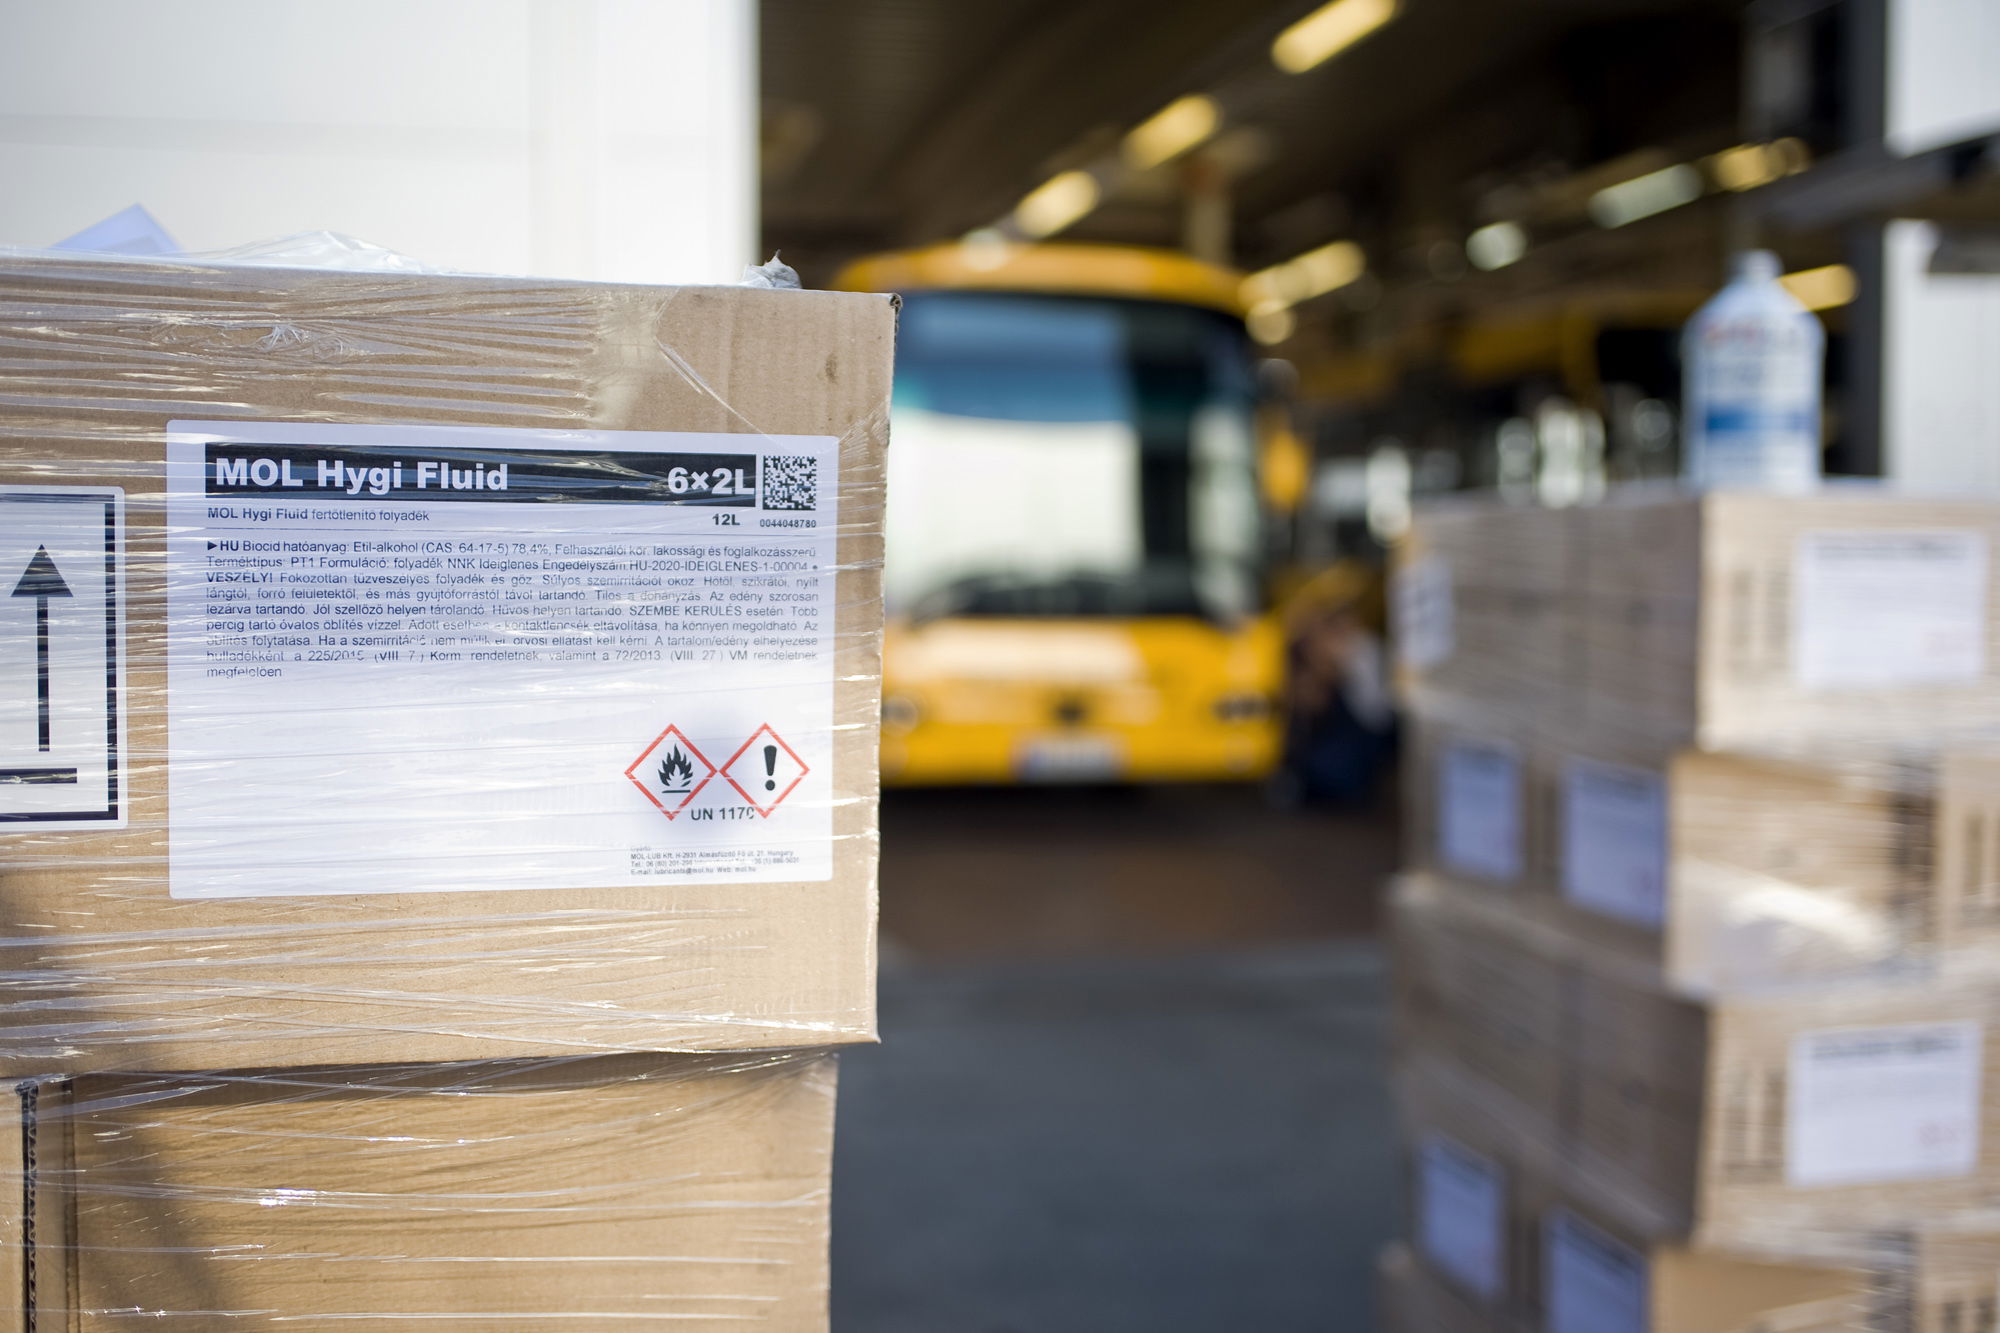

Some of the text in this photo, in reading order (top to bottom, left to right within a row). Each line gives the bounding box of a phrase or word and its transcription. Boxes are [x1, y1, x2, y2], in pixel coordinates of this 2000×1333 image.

[215, 457, 509, 496] MOL Hygi Fluid
[207, 507, 238, 519] MOL
[242, 507, 272, 522] Hygi
[276, 508, 308, 520] Fluid
[379, 511, 430, 524] folyadék
[712, 513, 741, 527] 12L
[759, 519, 817, 529] 0044048780
[220, 541, 239, 552] HU
[243, 541, 280, 552] Biocid
[353, 541, 418, 553] Etil-alkohol
[458, 543, 509, 556] 64-17-5)
[653, 545, 705, 559] lakossági
[708, 546, 721, 557] és
[290, 556, 315, 568] PT1
[394, 557, 443, 572] folyadék
[447, 558, 476, 569] NNK
[479, 558, 539, 572] Ideiglenes
[280, 572, 347, 584] Fokozottan
[436, 573, 485, 587] folyadék
[491, 574, 505, 585] és
[542, 574, 581, 588] Súlyos
[257, 588, 286, 599] forró
[366, 588, 380, 599] és
[386, 588, 411, 599] más
[505, 590, 533, 601] távol
[595, 590, 621, 601] Tilos
[710, 591, 724, 602] Az
[729, 590, 763, 604] edény
[769, 594, 818, 603] szorosan
[206, 604, 251, 615] lezárva
[313, 604, 330, 615] Jól
[387, 605, 426, 617] helyen
[533, 605, 572, 618] helyen
[629, 605, 680, 617] SZEMBE
[206, 619, 244, 632] percig
[249, 619, 276, 630] tartó
[280, 619, 319, 630] óvatos
[324, 619, 364, 630] öblítés
[408, 619, 439, 631] Adott
[664, 621, 679, 631] ha
[804, 621, 818, 632] Az
[318, 635, 336, 646] Ha
[340, 638, 348, 646] a
[431, 636, 455, 646] nem
[513, 636, 548, 646] orvosi
[597, 636, 616, 646] kell
[654, 636, 664, 646] A
[667, 635, 749, 649] tartalom/edény
[294, 653, 302, 662] a
[602, 653, 609, 661] a
[729, 650, 748, 661] VM
[690, 808, 713, 820] UN
